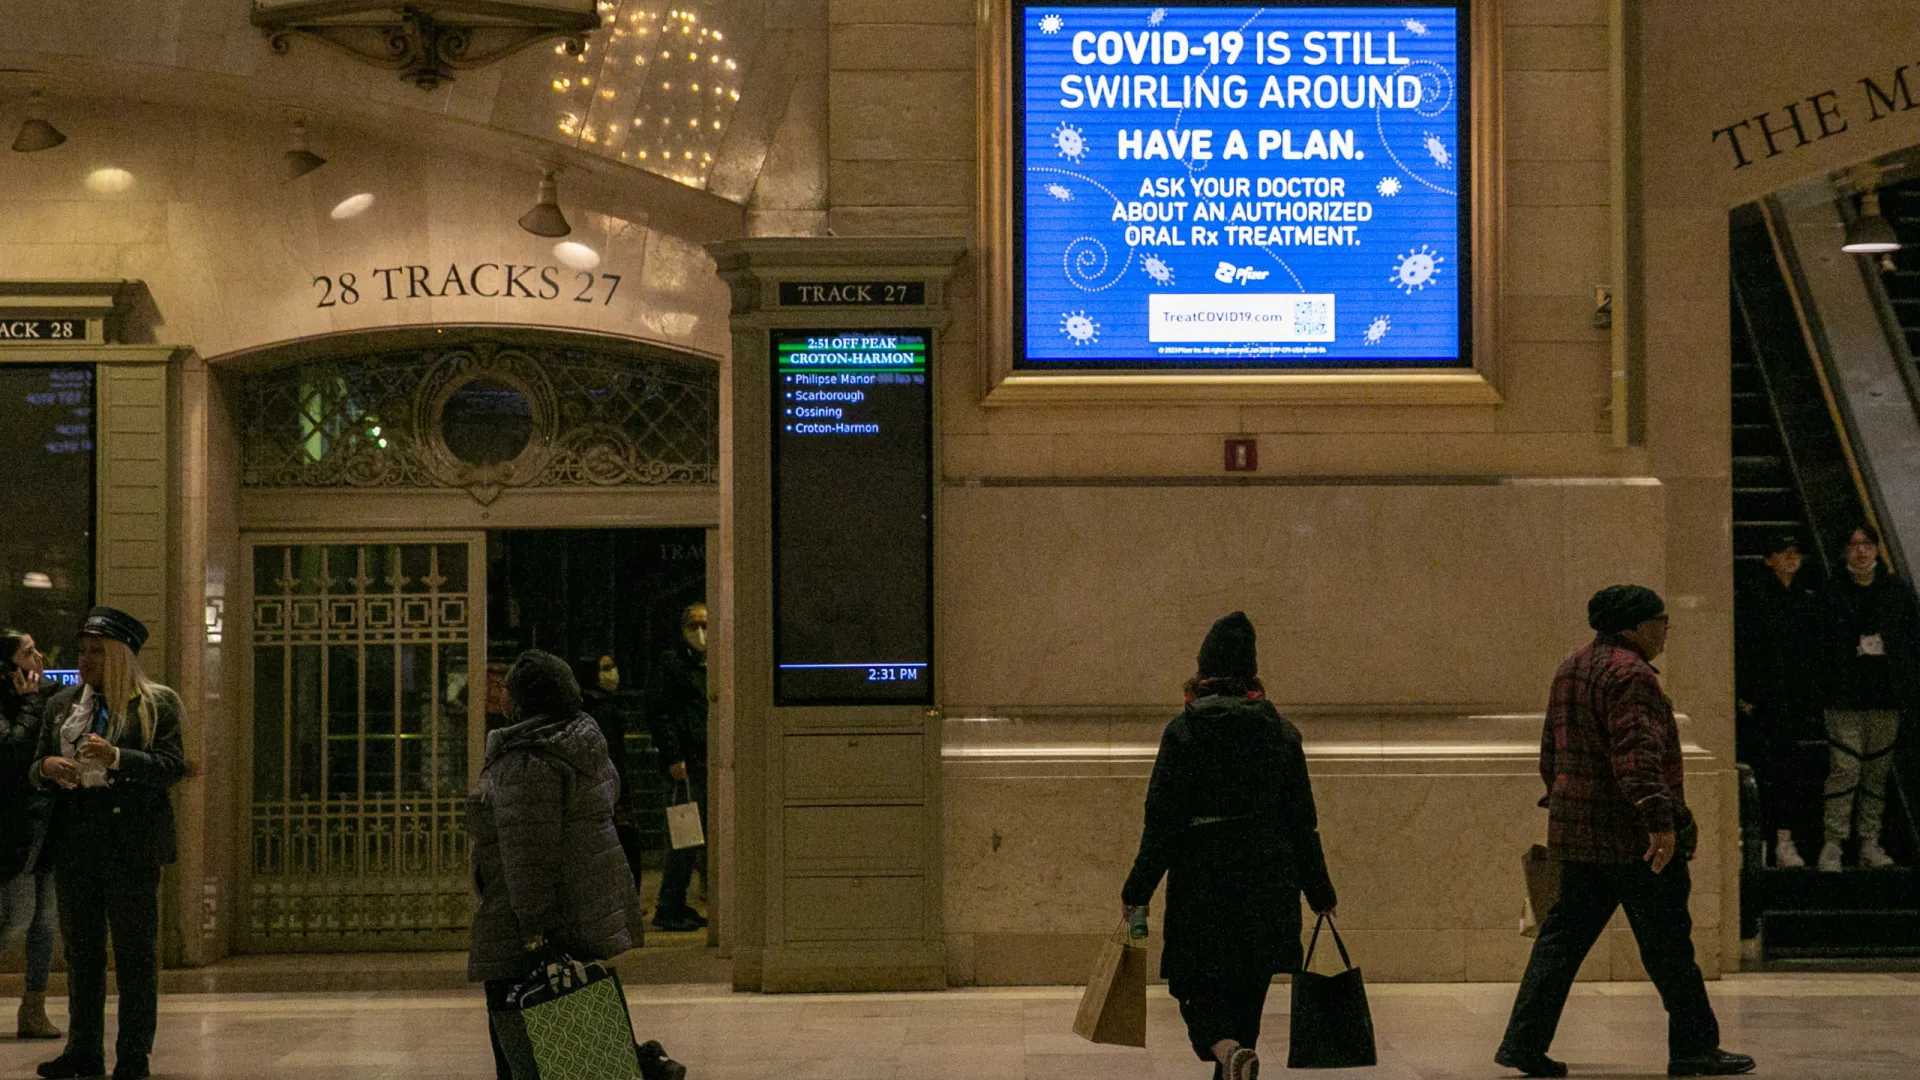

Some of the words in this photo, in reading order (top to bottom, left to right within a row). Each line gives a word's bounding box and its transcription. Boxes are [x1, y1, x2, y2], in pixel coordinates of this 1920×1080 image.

[1072, 31, 1244, 65] COVID-19
[1256, 32, 1291, 65] IS
[1303, 31, 1410, 65] STILL
[1060, 75, 1248, 109] SWIRLING
[1259, 75, 1422, 109] AROUND
[1712, 90, 1849, 170] THE
[1857, 61, 1920, 122] M
[1118, 130, 1213, 160] HAVE
[1223, 130, 1249, 160] A
[1258, 130, 1364, 160] PLAN.
[1139, 177, 1185, 198] ASK
[1190, 177, 1250, 198] YOUR
[1257, 177, 1345, 198] DOCTOR
[1111, 201, 1187, 222] ABOUT
[1193, 201, 1226, 222] AN
[1232, 201, 1373, 222] AUTHORIZED
[1124, 226, 1186, 247] ORAL
[1191, 226, 1219, 246] Rx
[1226, 226, 1361, 246] TREATMENT.
[313, 272, 359, 308] 28
[372, 263, 559, 300] TRACKS
[573, 271, 621, 306] 27
[798, 285, 872, 302] TRACK
[884, 285, 907, 302] 27
[1163, 311, 1283, 323] TreatCOVID19.com
[51, 321, 73, 339] 28
[807, 338, 830, 350] 2:51
[832, 337, 858, 349] OFF
[861, 337, 897, 349] PEAK
[790, 352, 914, 365] CROTON-HARMON
[795, 374, 837, 386] Philipse
[840, 373, 876, 385] Manor
[795, 390, 865, 403] Scarborough
[795, 407, 843, 419] Ossining
[795, 423, 880, 434] Croton-Harmon
[868, 668, 896, 681] 2:31
[900, 668, 918, 680] PM
